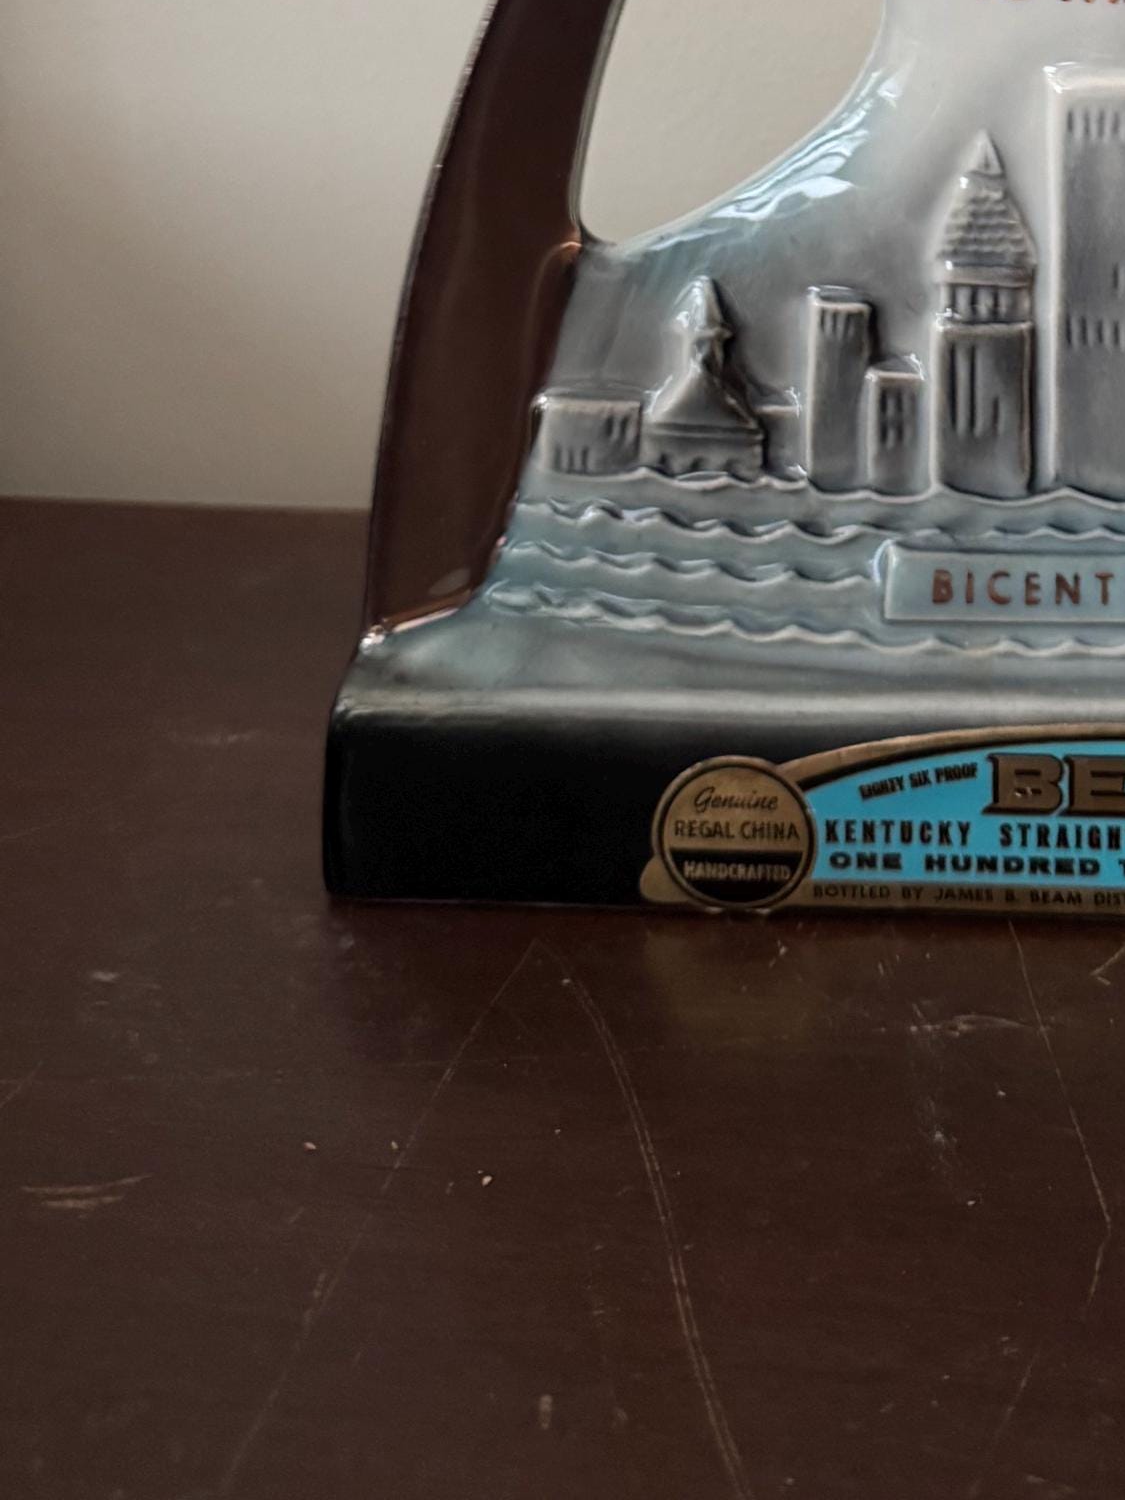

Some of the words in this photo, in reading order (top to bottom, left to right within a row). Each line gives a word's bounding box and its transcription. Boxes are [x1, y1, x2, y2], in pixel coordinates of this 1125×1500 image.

[909, 769, 932, 788] SIX
[935, 762, 978, 783] PROOF
[693, 786, 778, 813] Genuine
[674, 820, 735, 839] REGAL
[740, 821, 799, 840] CHINA
[825, 819, 971, 846] KENTUCKY
[683, 860, 791, 882] HANDCRAFTED
[829, 853, 901, 870] ONE
[925, 855, 1100, 876] HUNDRED
[813, 884, 891, 899] BOTTLED
[901, 886, 924, 899] BY
[934, 887, 993, 902] JAMES
[1030, 889, 1082, 906] BEAM
